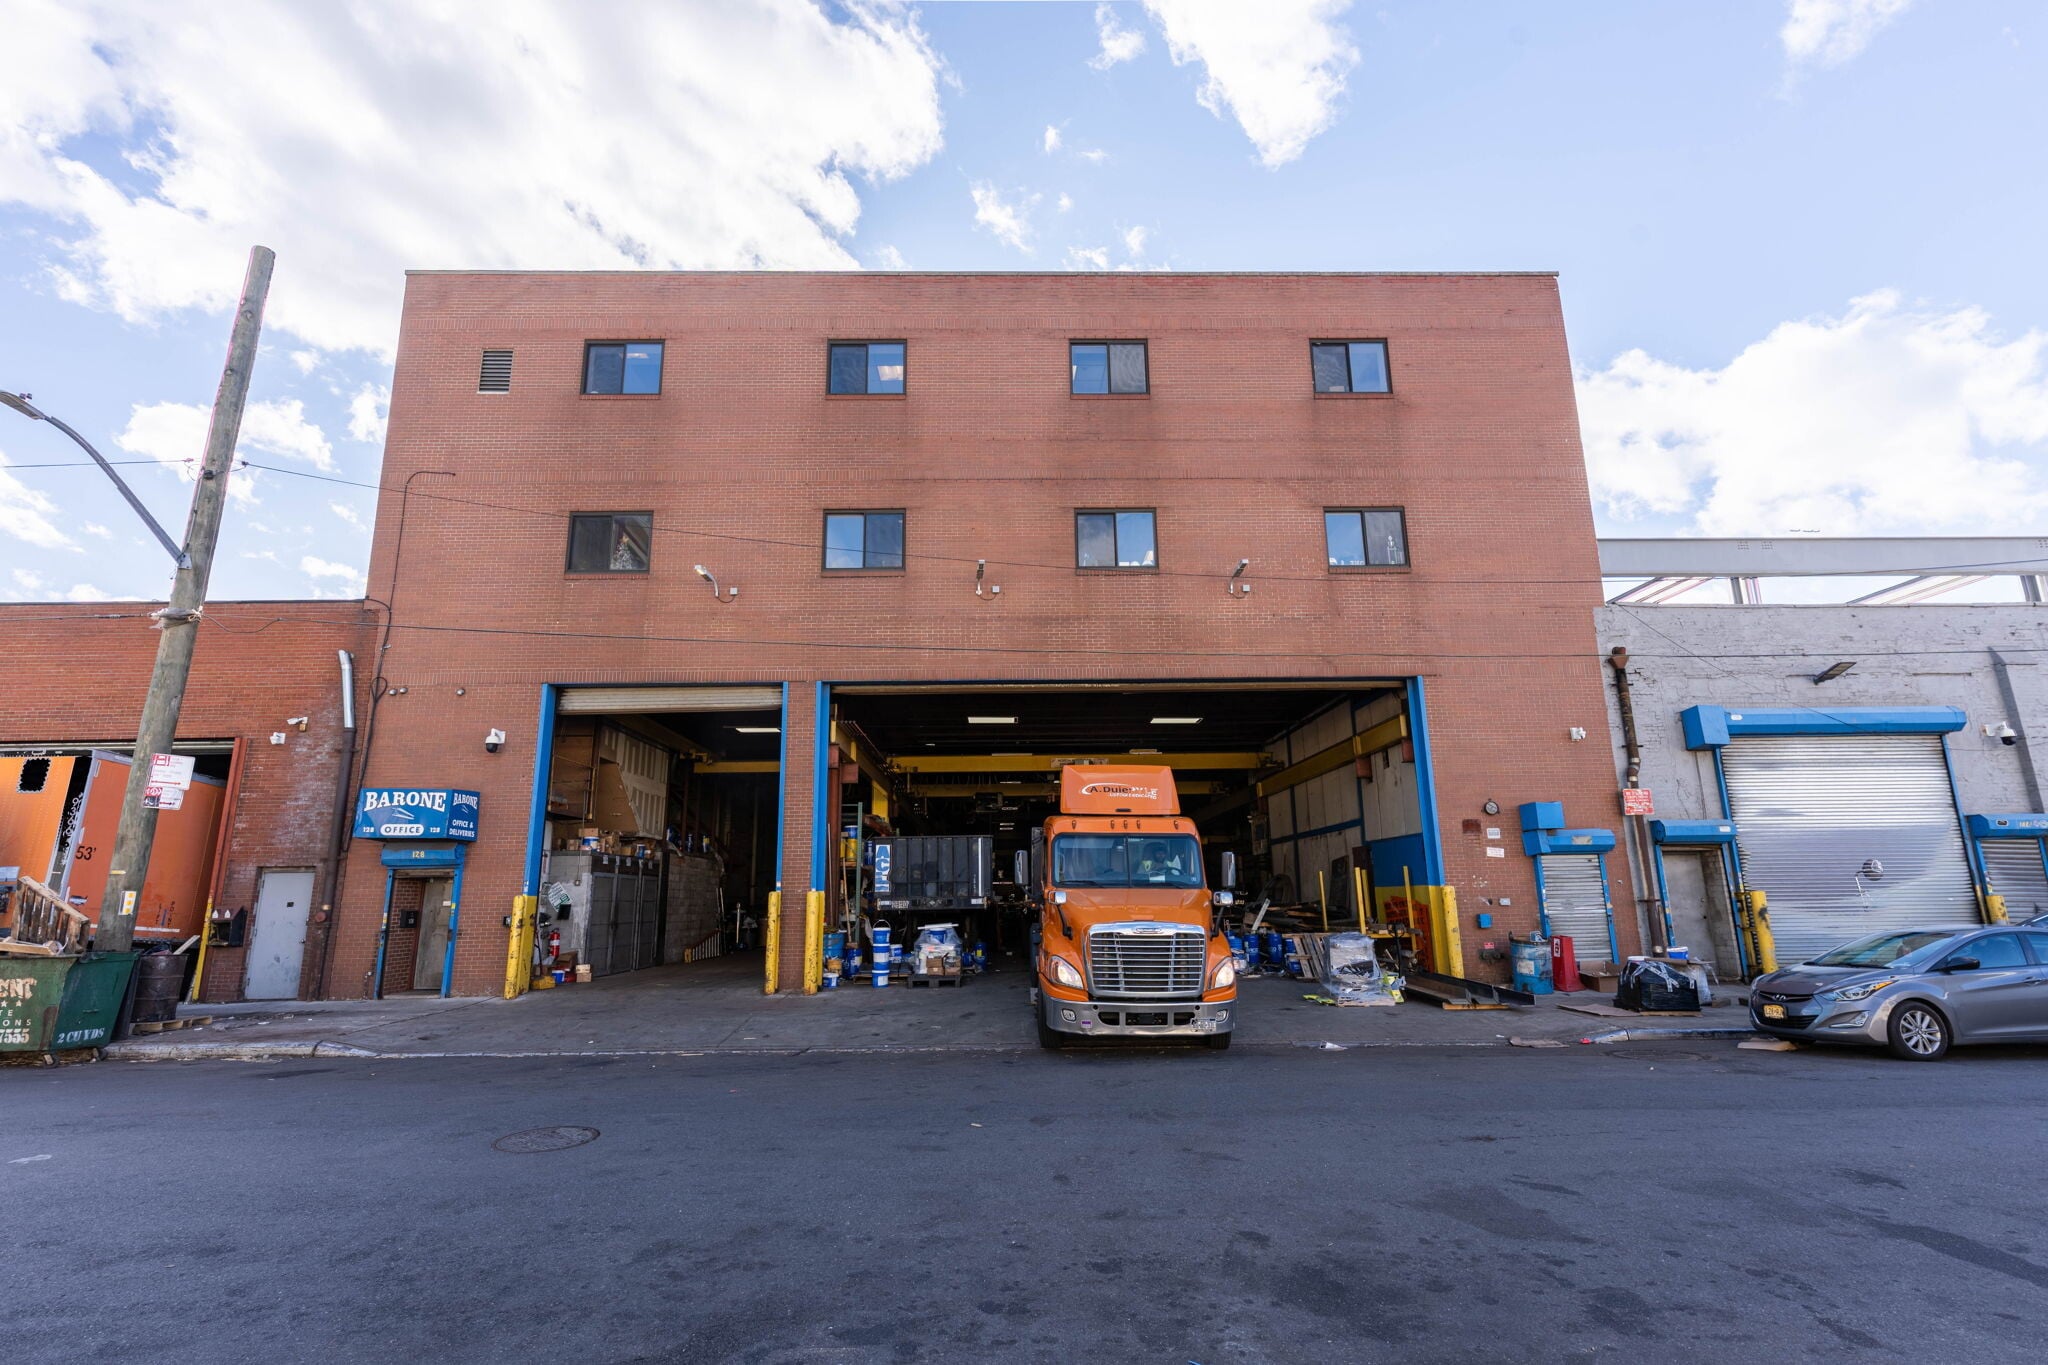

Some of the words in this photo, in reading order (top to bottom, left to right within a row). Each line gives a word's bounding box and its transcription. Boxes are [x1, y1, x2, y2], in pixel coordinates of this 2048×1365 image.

[364, 791, 447, 812] BARONE
[453, 793, 478, 810] BARONE
[452, 819, 468, 827] OFFICE
[469, 821, 474, 829] &
[384, 826, 421, 834] OFFICE
[449, 828, 475, 838] DELIVERIES
[412, 851, 425, 859] 128
[57, 1033, 66, 1043] 2
[83, 1028, 105, 1040] YDS
